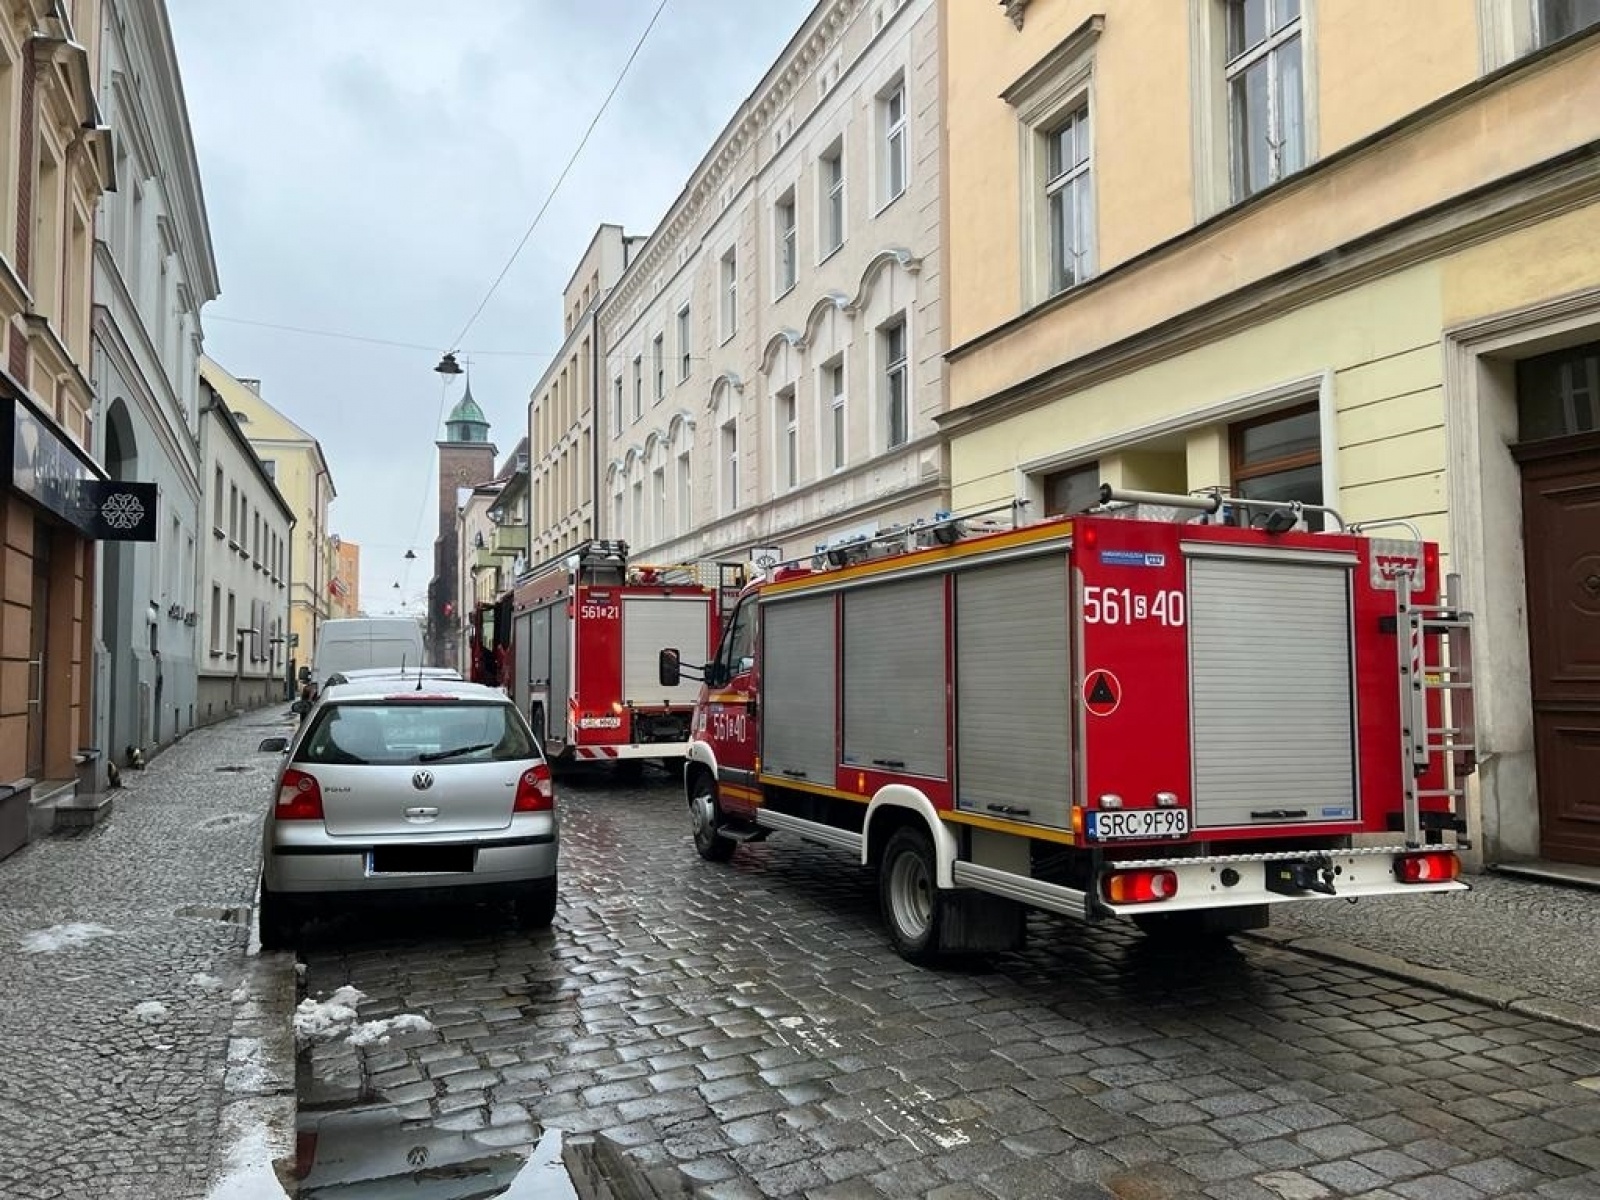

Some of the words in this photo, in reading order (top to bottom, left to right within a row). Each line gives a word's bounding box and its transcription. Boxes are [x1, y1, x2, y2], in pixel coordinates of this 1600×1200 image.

[1084, 586, 1131, 625] 561
[1151, 590, 1184, 626] 40
[1099, 813, 1137, 835] SRC
[1143, 811, 1185, 833] 9F98
